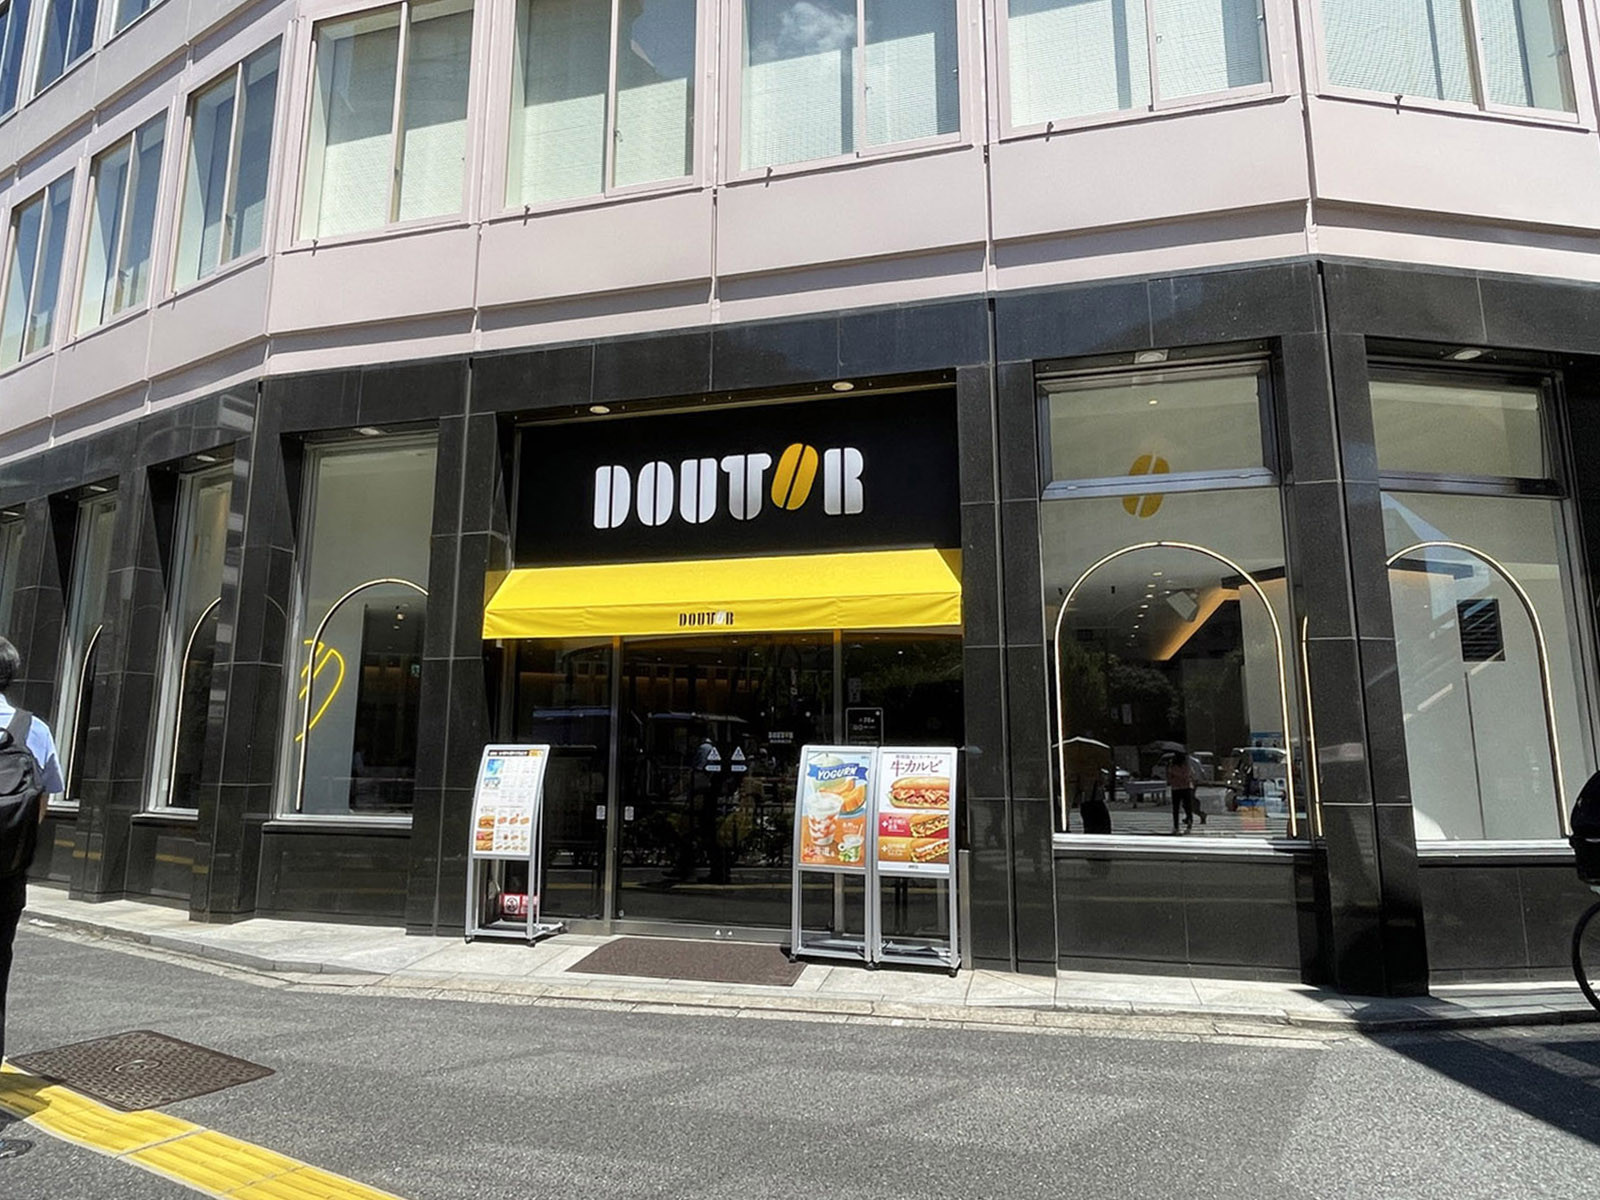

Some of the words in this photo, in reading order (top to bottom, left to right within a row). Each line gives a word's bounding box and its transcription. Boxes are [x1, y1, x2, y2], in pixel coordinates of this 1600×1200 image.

[593, 443, 864, 529] DOUTOR
[679, 609, 734, 626] DOUTOR
[890, 759, 943, 777] 牛カルビ
